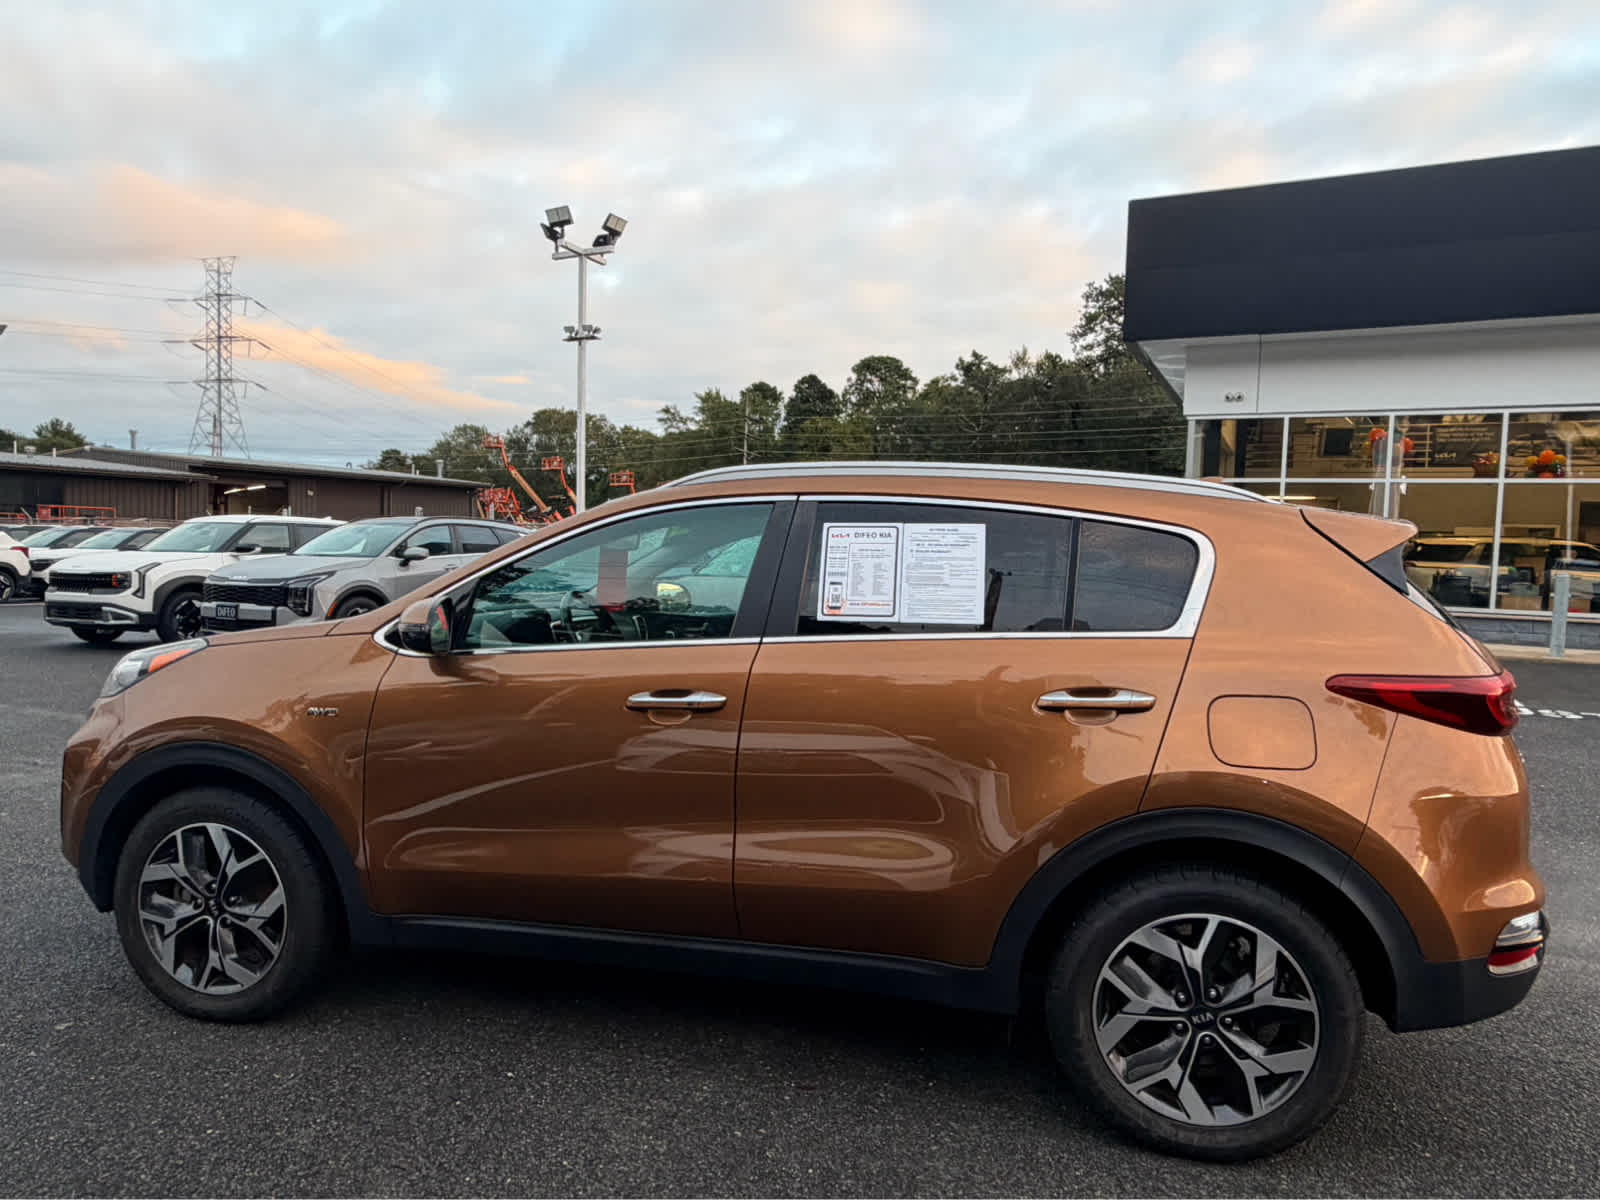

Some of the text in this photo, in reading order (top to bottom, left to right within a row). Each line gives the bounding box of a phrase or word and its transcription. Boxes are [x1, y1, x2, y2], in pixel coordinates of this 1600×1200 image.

[217, 606, 236, 617] DIFEO
[307, 706, 338, 717] AWD
[1190, 1011, 1215, 1024] KIA
